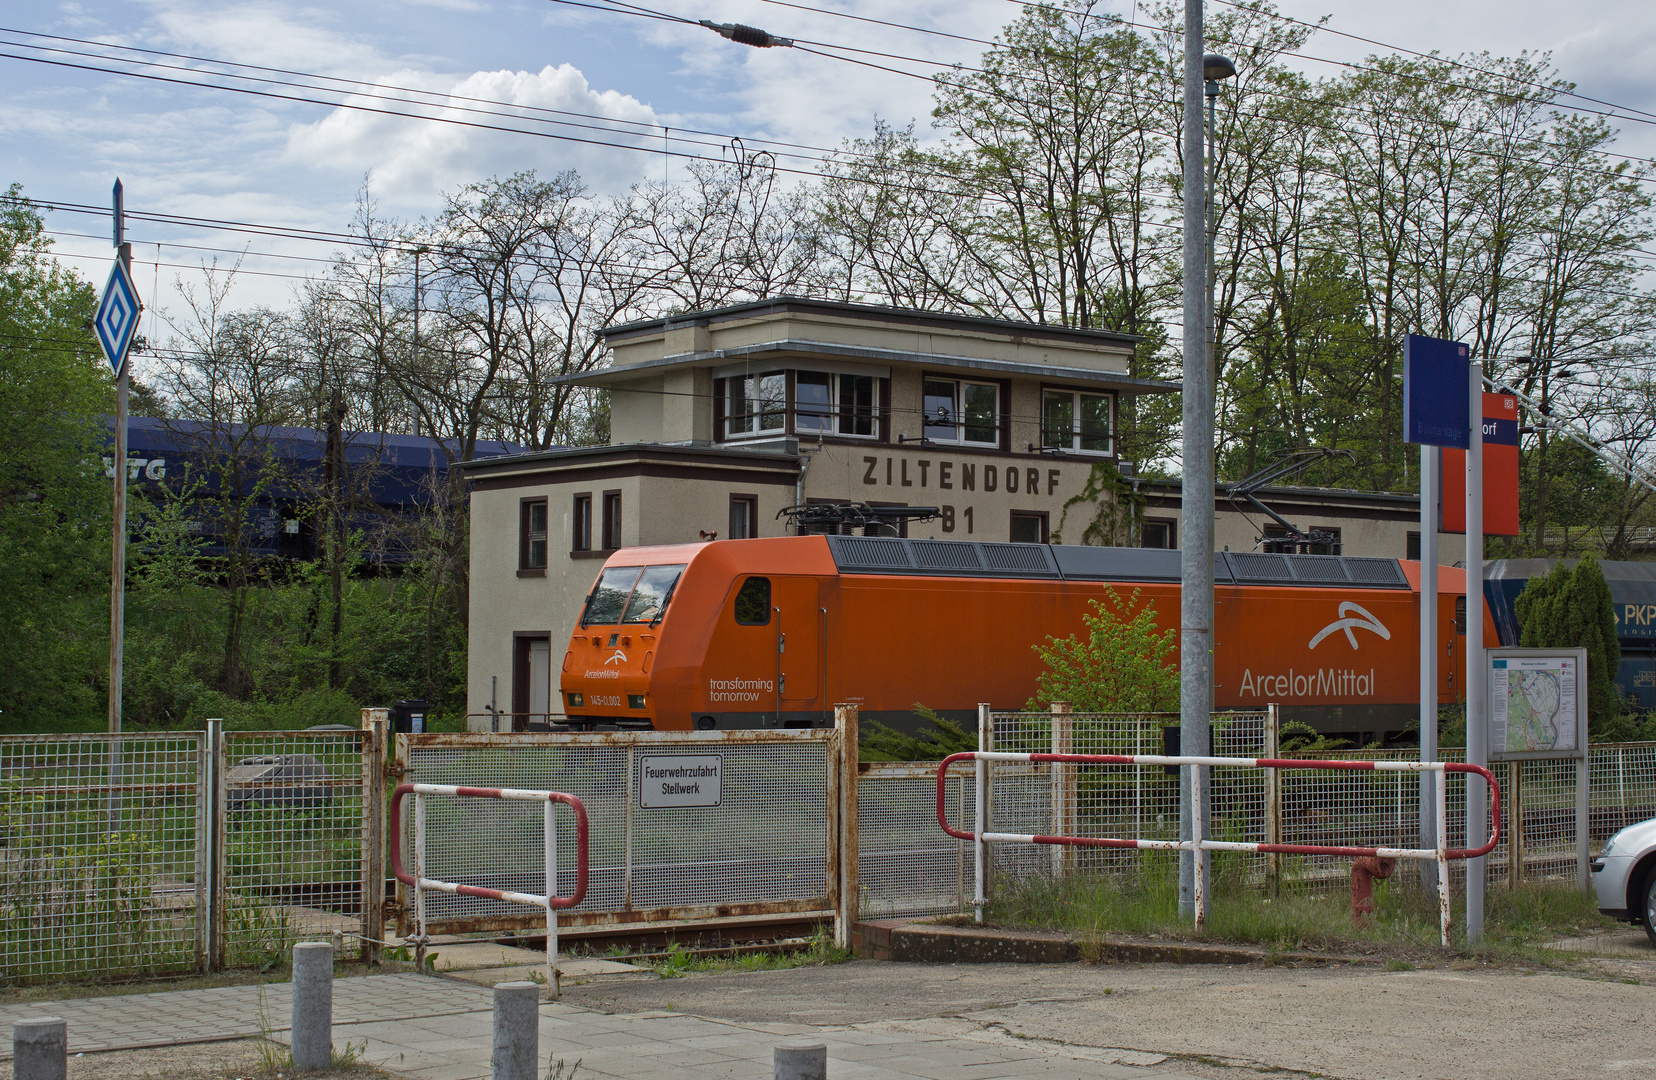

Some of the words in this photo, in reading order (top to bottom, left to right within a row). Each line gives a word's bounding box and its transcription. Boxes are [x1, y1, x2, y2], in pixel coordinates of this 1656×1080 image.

[1504, 399, 1513, 409] DB
[863, 456, 1060, 495] ZILTENDORF
[584, 669, 620, 679] ArcelorMittal
[710, 677, 773, 692] transforming
[1239, 668, 1374, 697] ArcelorMittal
[710, 690, 760, 702] tomorrow
[645, 765, 718, 778] Feuerwehrzufahrt
[661, 782, 700, 795] Stellwerk
